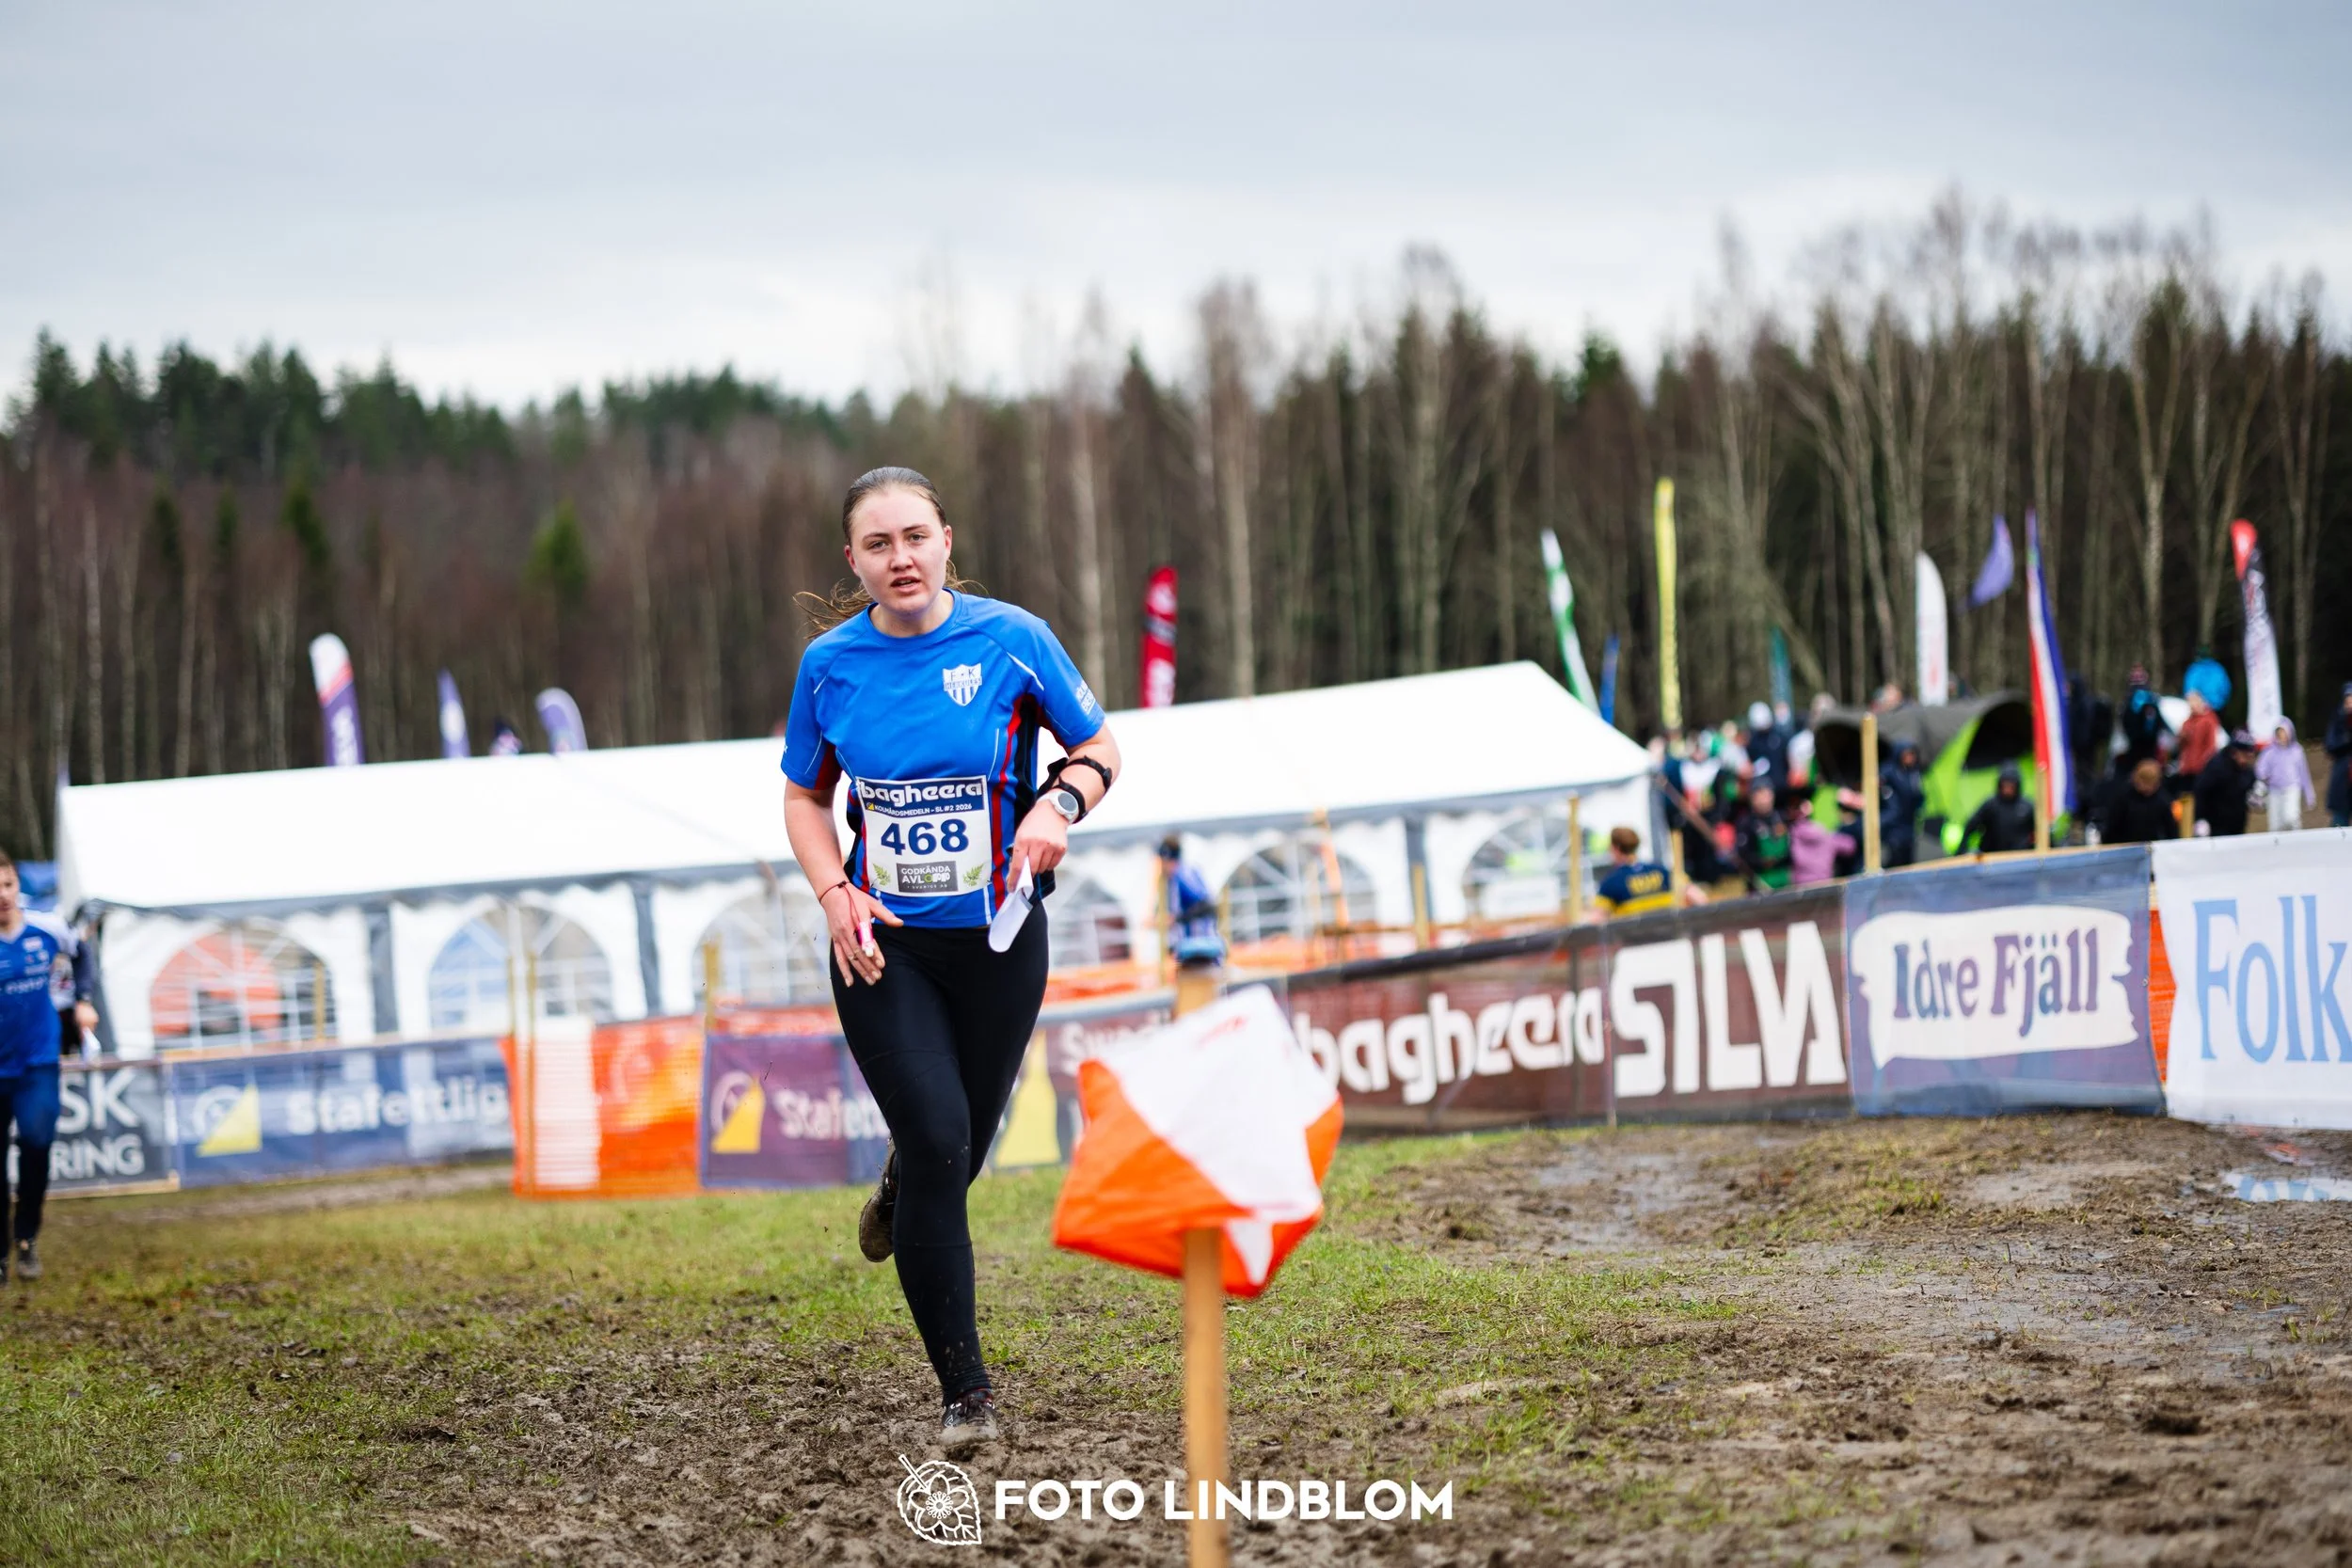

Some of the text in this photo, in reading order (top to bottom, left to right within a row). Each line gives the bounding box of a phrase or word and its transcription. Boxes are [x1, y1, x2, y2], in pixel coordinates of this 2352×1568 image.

[860, 782, 982, 807] bagheera
[875, 804, 930, 816] KOLMÅRDSMEDELN
[881, 818, 969, 855] 468
[900, 864, 951, 876] GODKÄNDA
[1610, 920, 1848, 1099] SILVA
[1894, 927, 2098, 1037] Idre Fjäll
[2193, 895, 2352, 1064] Folk
[1295, 992, 1605, 1105] bagheera
